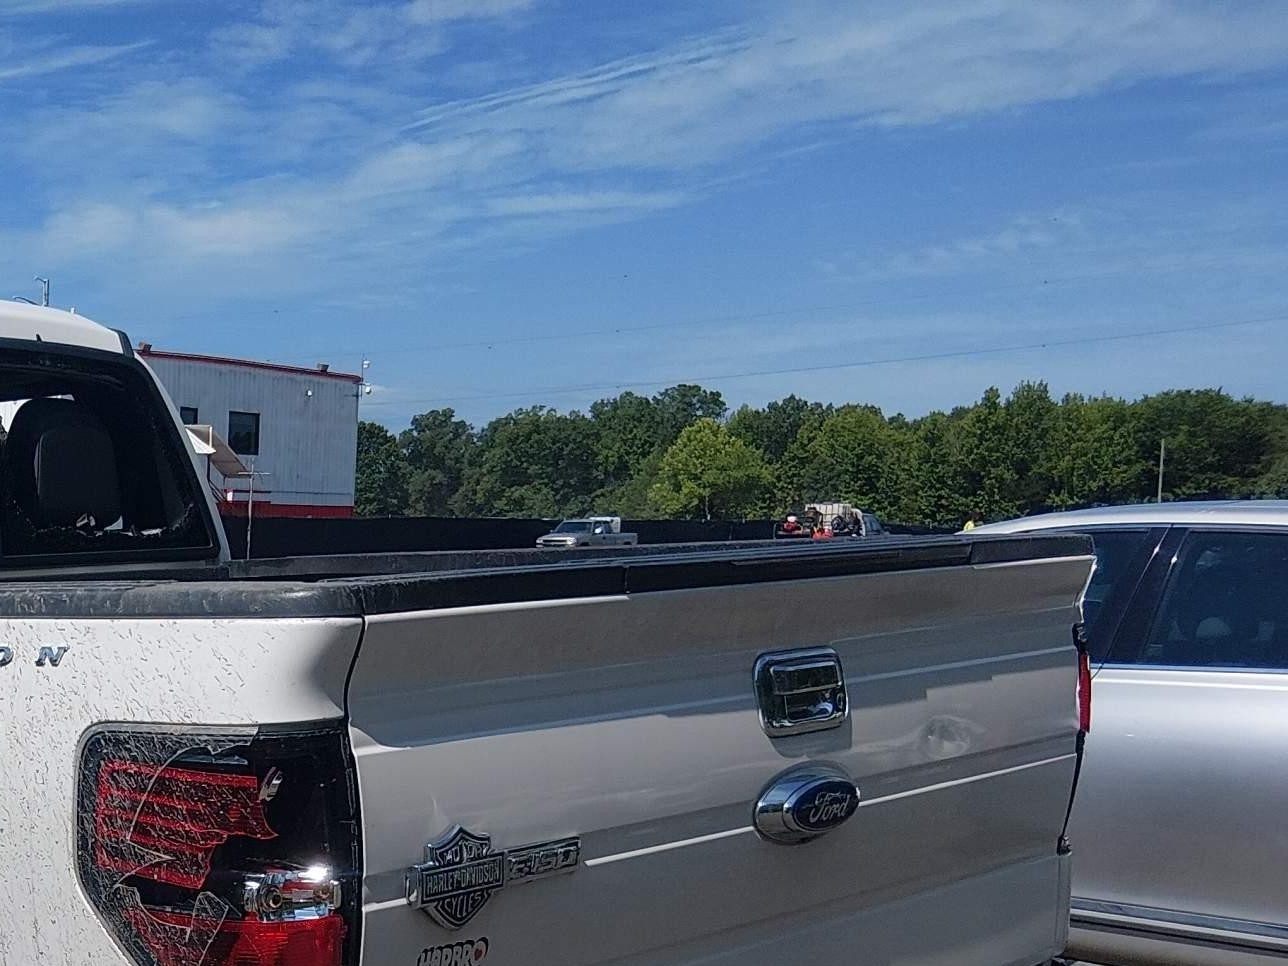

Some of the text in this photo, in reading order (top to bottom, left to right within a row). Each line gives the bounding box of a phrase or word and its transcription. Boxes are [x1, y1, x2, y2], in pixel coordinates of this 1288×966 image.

[808, 791, 851, 823] Ford
[426, 860, 501, 896] HARLEY-DAVIDSON
[507, 845, 579, 880] F-150
[444, 890, 483, 919] CYCLES
